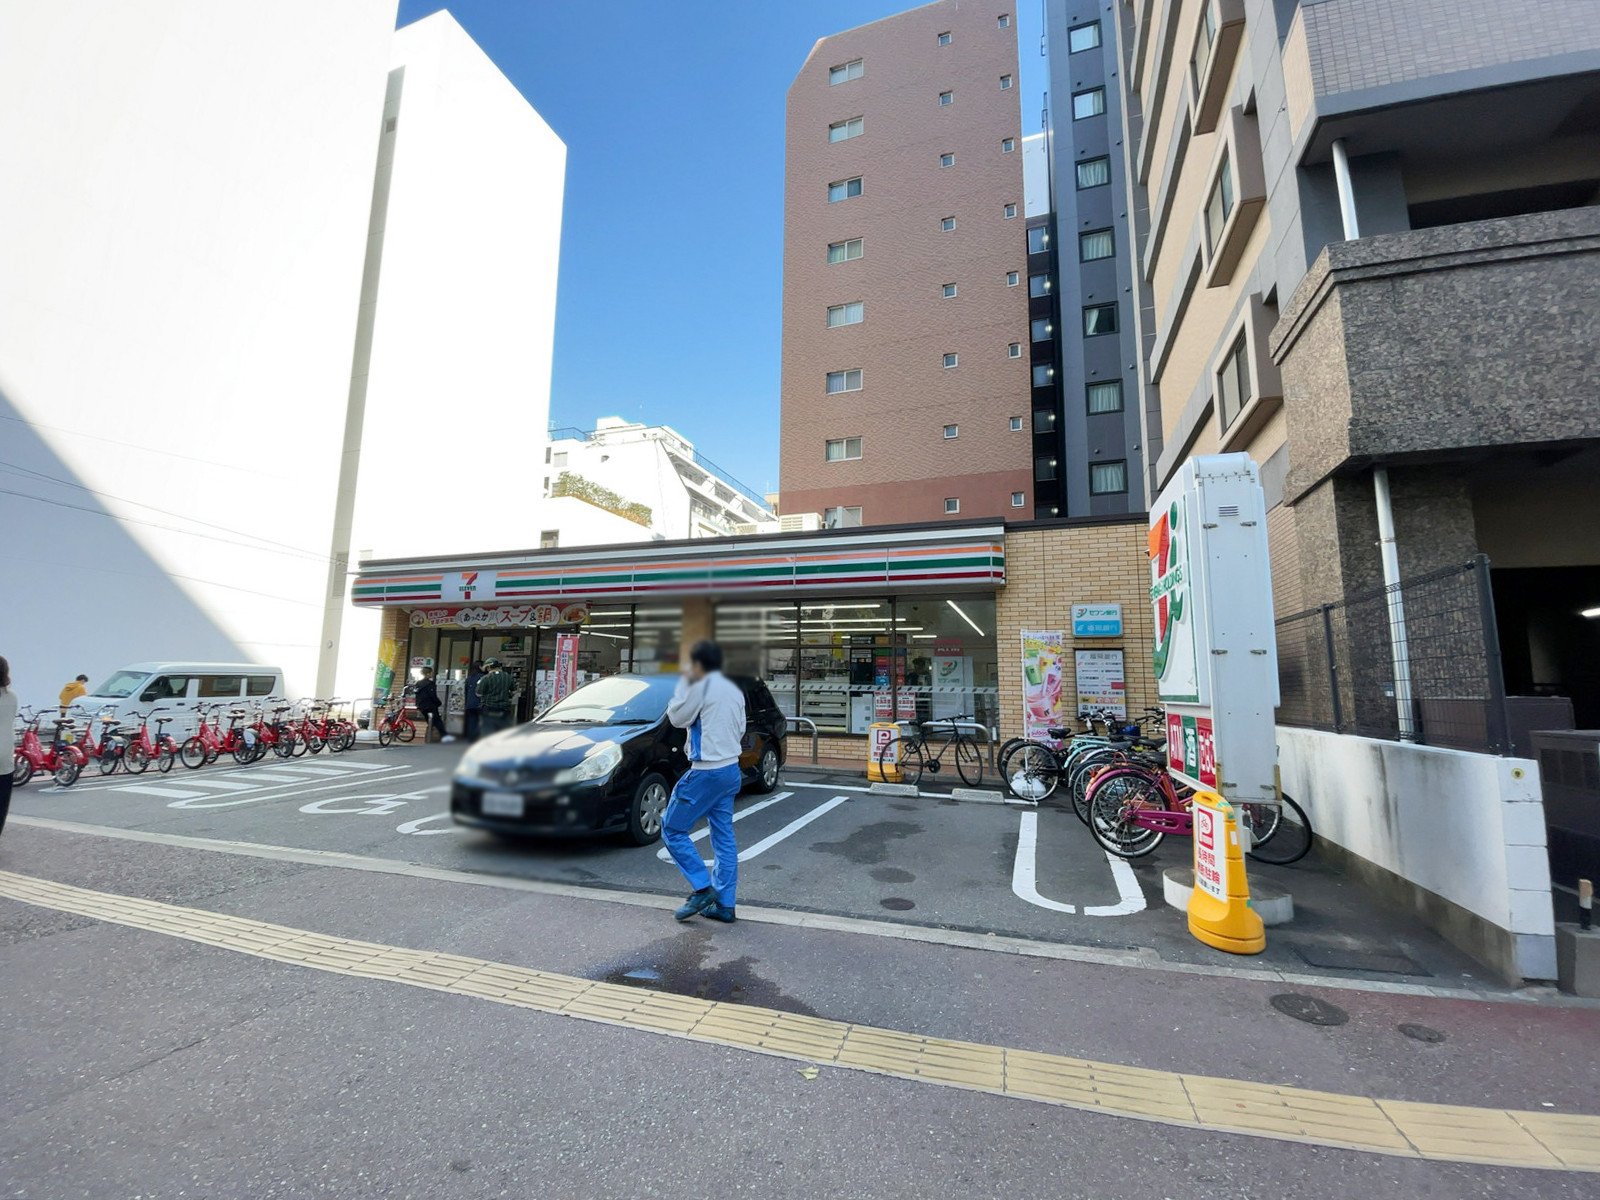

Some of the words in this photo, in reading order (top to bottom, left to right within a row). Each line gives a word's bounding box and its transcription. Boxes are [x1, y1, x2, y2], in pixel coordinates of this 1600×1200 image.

[463, 612, 489, 622] あったか
[1170, 724, 1183, 761] ATM
